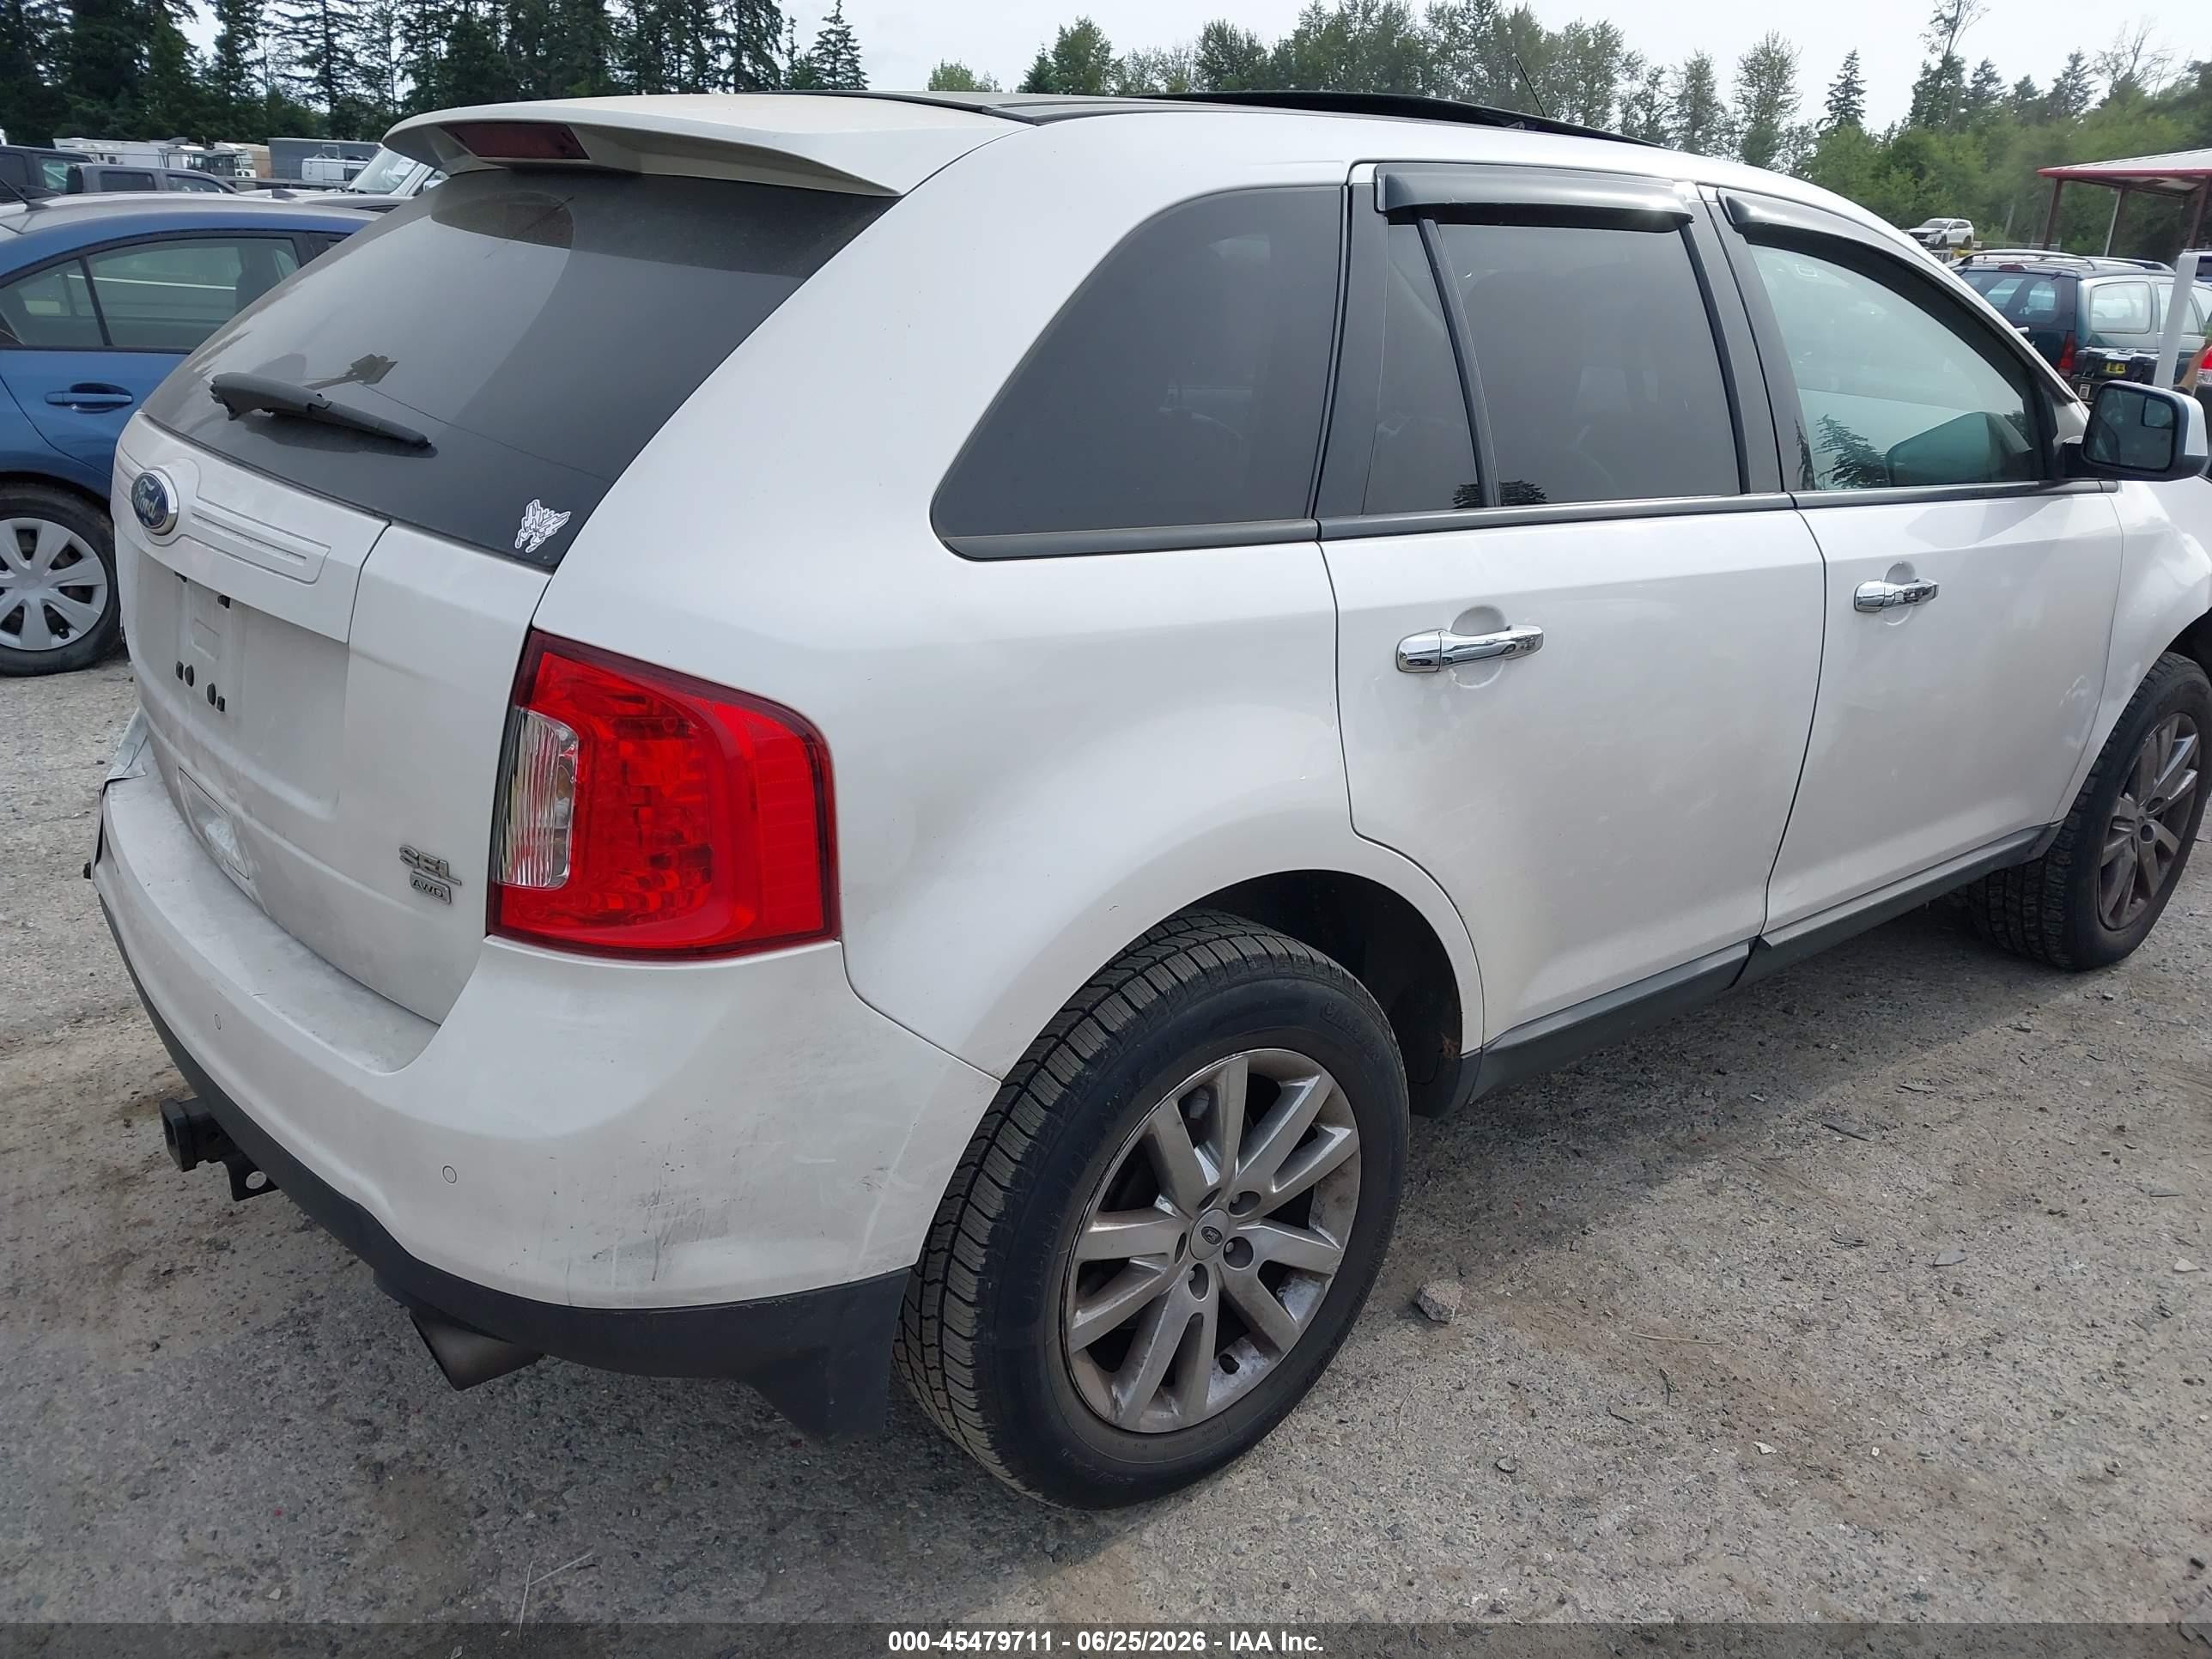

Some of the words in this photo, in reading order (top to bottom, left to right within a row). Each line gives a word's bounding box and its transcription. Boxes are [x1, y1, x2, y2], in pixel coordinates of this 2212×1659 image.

[135, 478, 158, 519] Ford
[399, 845, 461, 885] SEL
[413, 879, 444, 897] AWD
